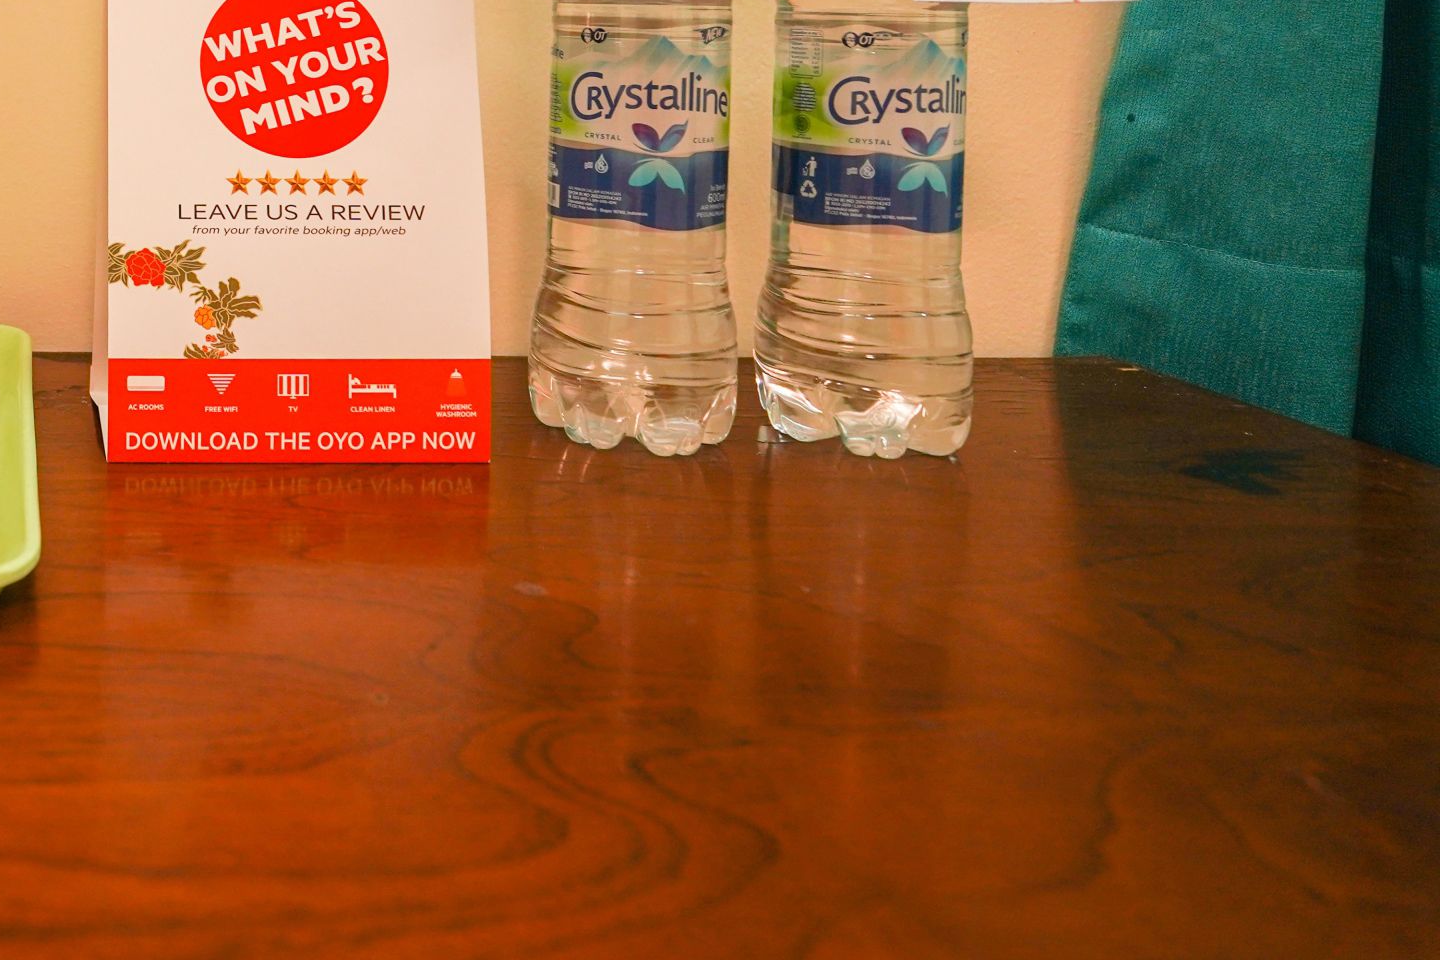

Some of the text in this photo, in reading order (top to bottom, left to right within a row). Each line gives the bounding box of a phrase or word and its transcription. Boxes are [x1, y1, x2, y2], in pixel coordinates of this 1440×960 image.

[203, 1, 361, 62] WHAT'S
[206, 36, 386, 103] ON YOUR
[239, 76, 375, 136] MIND?
[584, 132, 622, 142] CRYSTAL
[848, 137, 892, 147] CRYSTAL
[178, 204, 426, 221] LEAVE US A REVIEW
[192, 225, 407, 237] from your favorite booking app/web
[440, 403, 472, 411] HYGIENIC
[125, 431, 476, 451] DOWNLOAD THE OYO APP NOW
